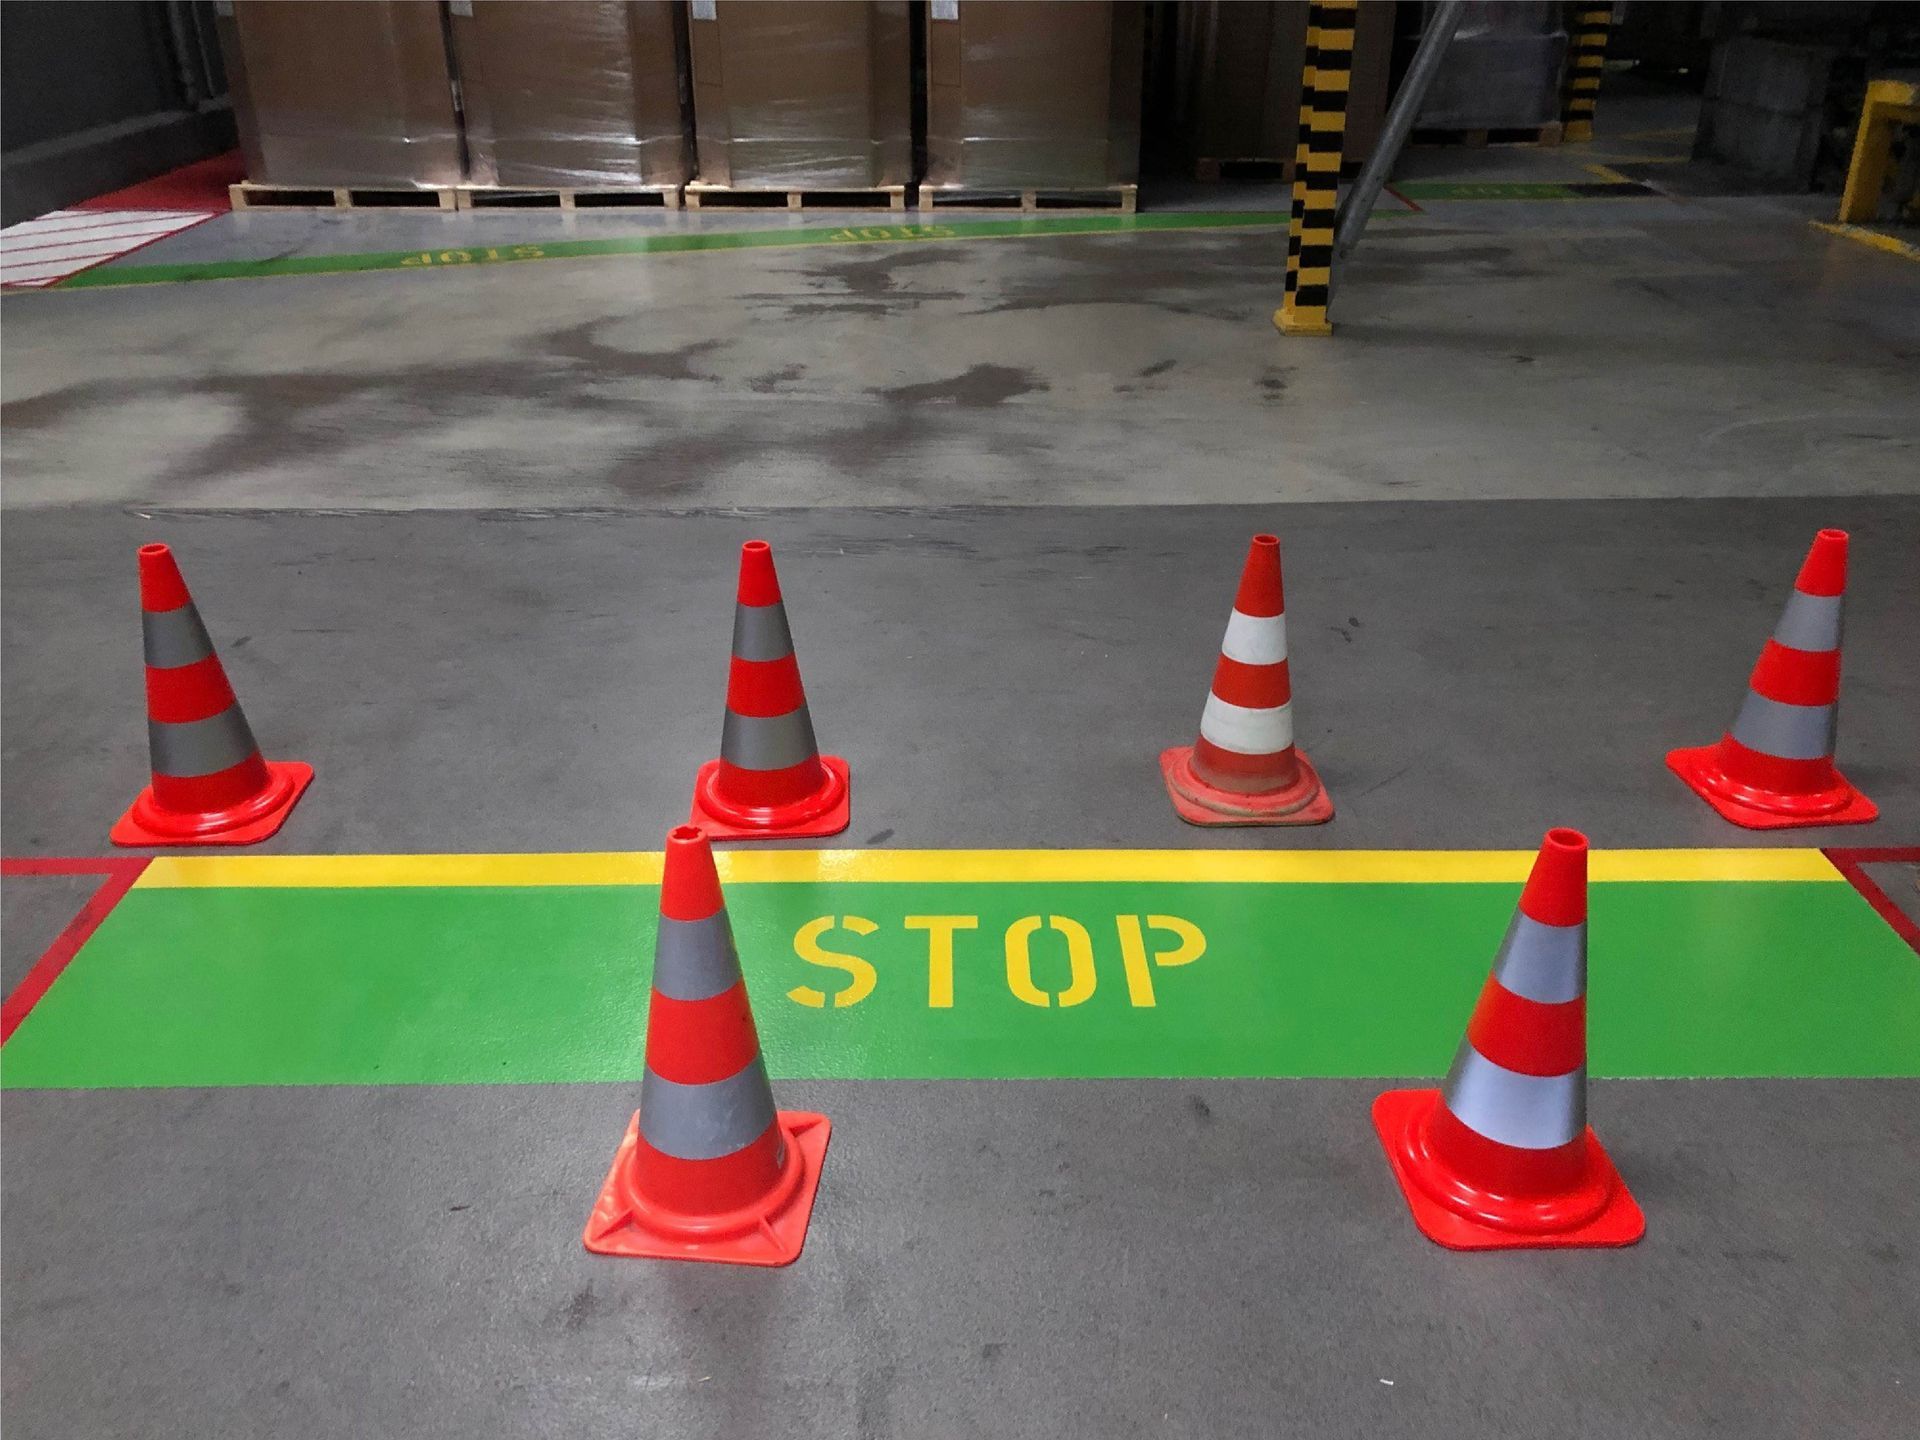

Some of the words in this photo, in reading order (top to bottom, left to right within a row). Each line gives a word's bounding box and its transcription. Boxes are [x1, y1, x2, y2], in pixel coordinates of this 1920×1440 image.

[830, 225, 955, 241] STOP
[401, 244, 544, 265] STOP
[785, 914, 1206, 1008] STOP
